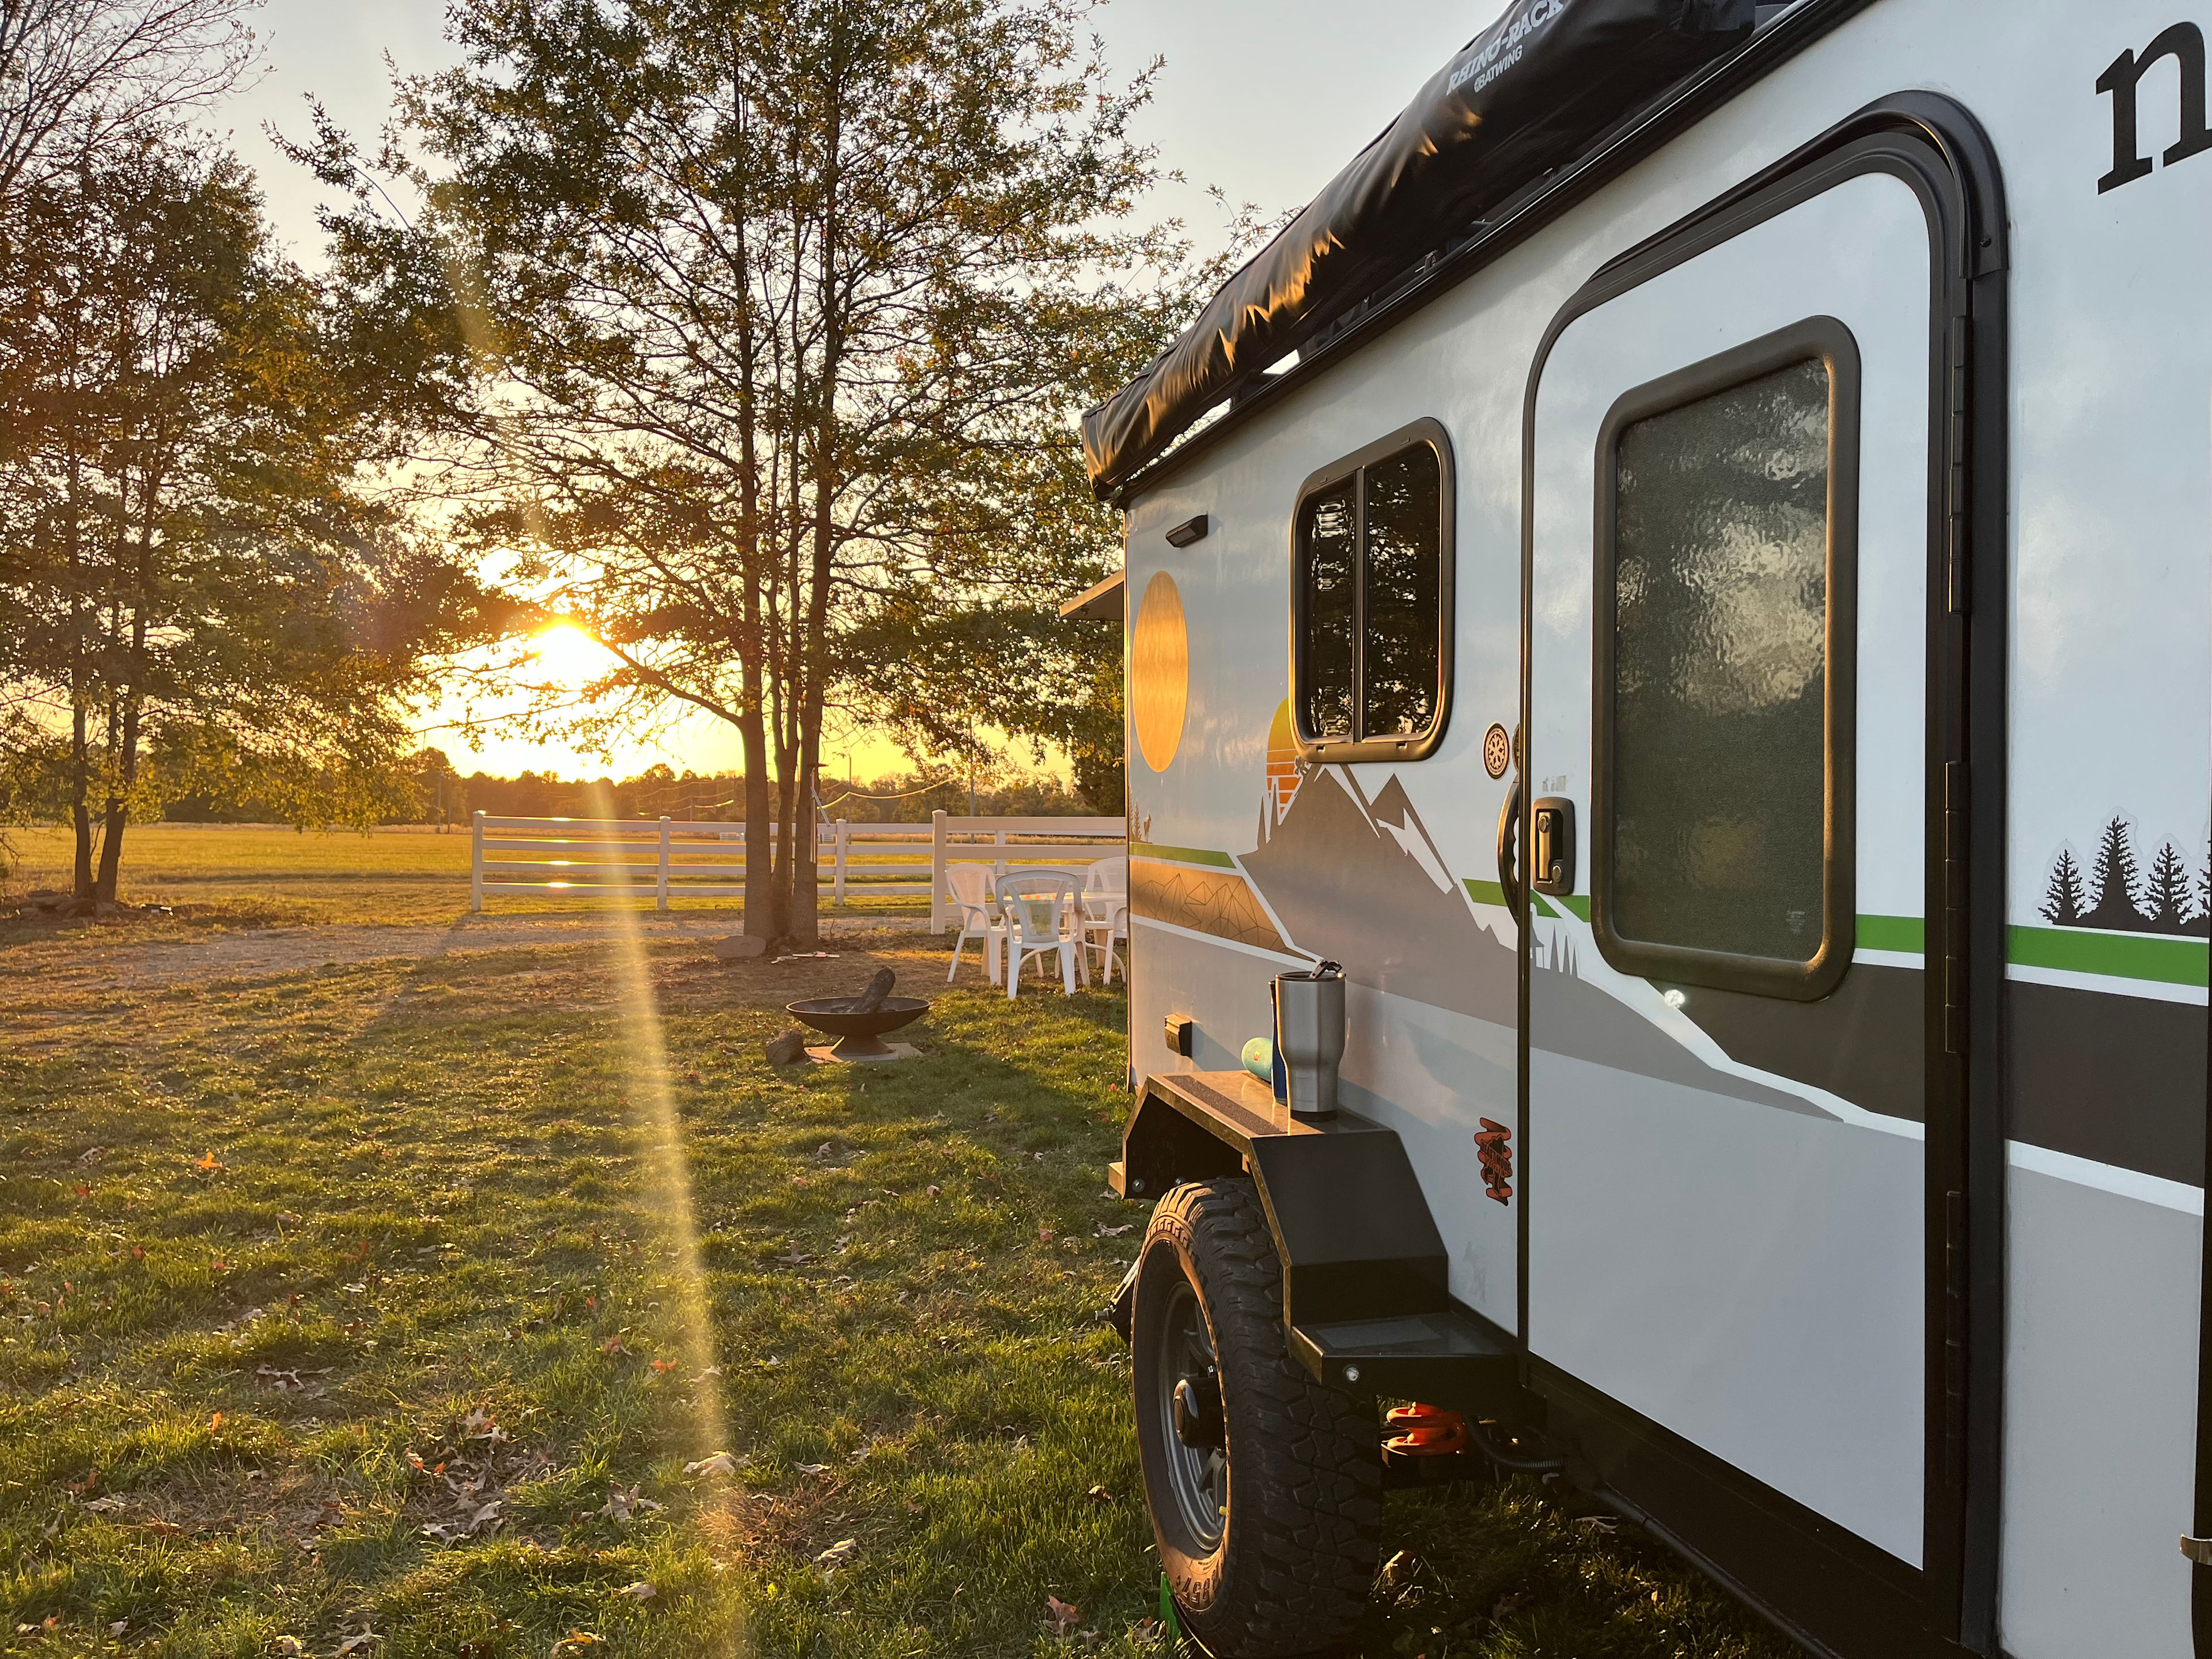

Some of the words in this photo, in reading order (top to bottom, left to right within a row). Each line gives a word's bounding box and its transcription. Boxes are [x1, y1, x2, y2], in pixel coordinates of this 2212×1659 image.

[1446, 0, 1563, 96] RHINO-RACK
[1477, 44, 1522, 87] BATWING
[2096, 21, 2212, 195] n
